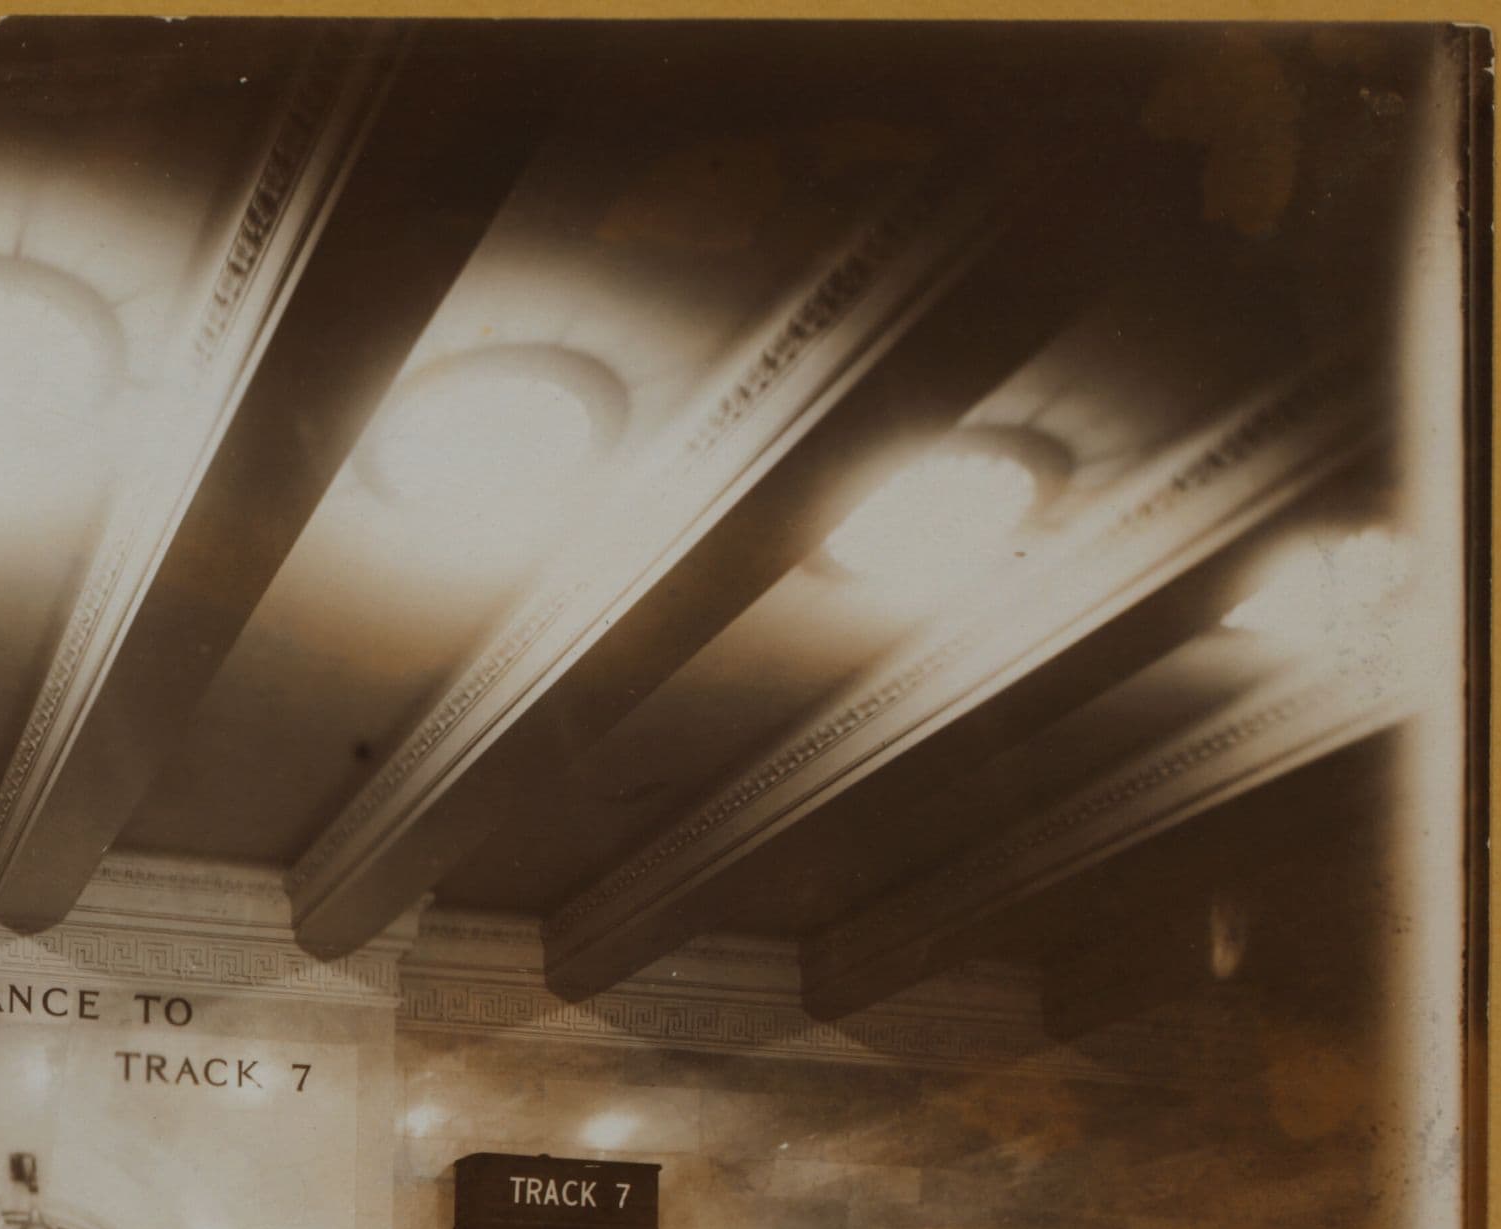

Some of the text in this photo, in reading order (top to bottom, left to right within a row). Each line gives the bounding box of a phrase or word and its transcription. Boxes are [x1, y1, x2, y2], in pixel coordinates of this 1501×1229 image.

[134, 994, 194, 1027] TO
[115, 1052, 312, 1092] TRACK 7
[509, 1177, 631, 1209] TRACK 7
